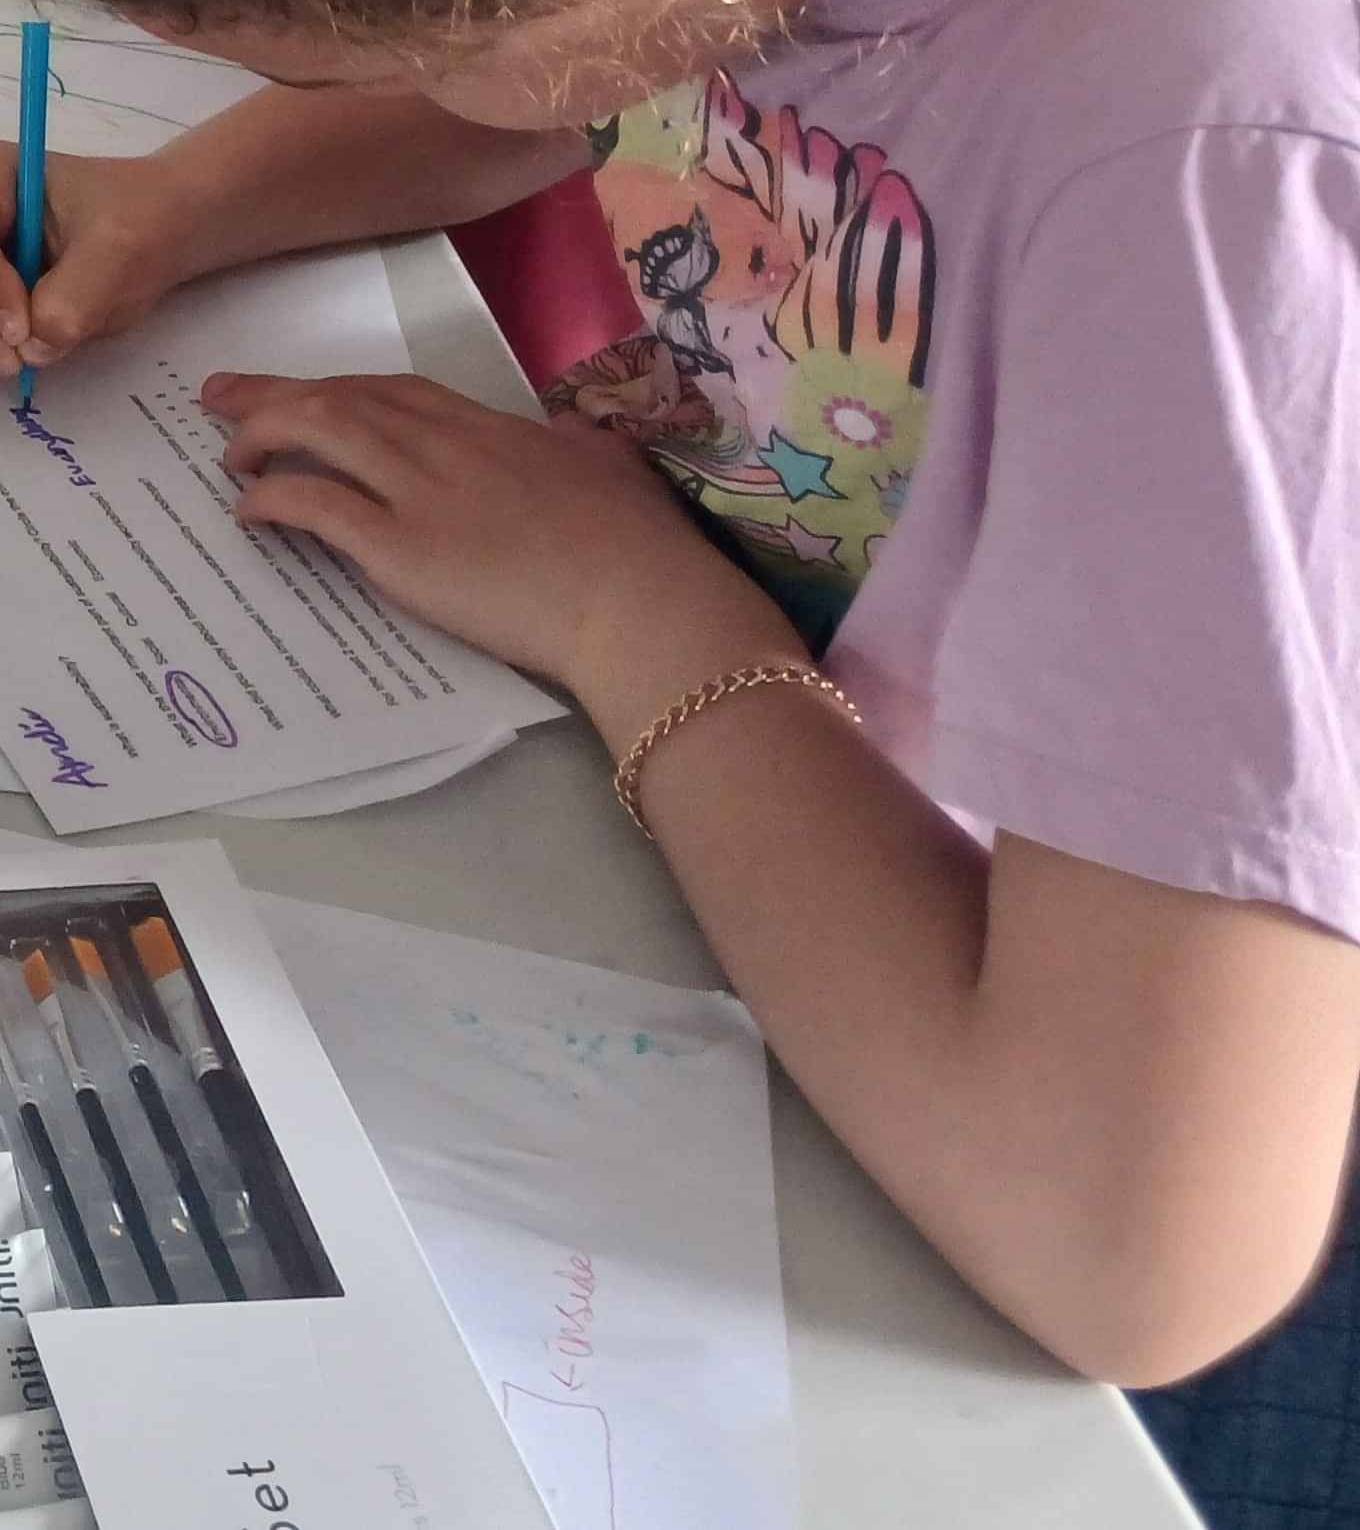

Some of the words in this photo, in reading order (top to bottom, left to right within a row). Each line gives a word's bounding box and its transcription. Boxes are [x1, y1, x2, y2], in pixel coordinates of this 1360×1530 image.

[7, 1345, 48, 1411] niti
[10, 1454, 26, 1488] 12ml
[37, 1428, 79, 1499] niti
